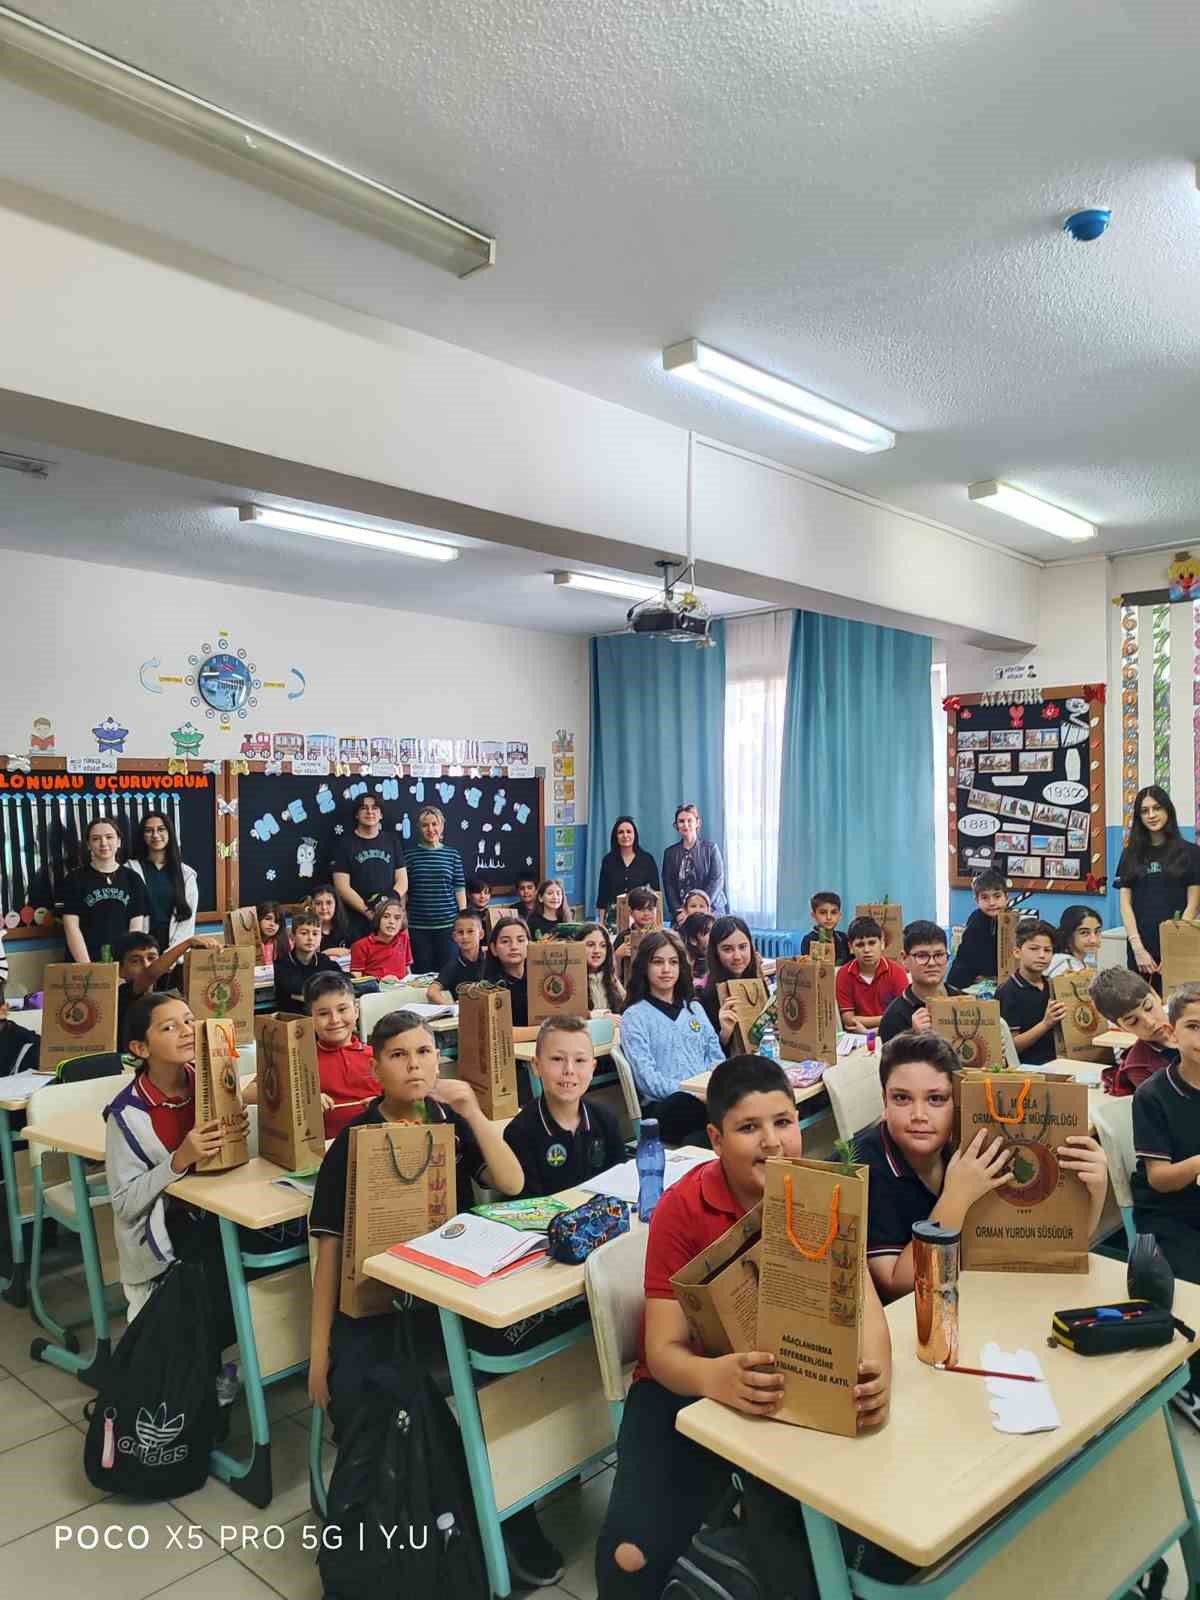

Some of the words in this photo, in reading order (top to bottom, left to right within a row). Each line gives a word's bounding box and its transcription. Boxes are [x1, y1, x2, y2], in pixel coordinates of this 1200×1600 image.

[95, 775, 209, 792] UÇURUYORUM
[961, 818, 997, 829] 1881
[976, 1226, 1004, 1239] ORMAN
[1005, 1226, 1036, 1239] YURDUN
